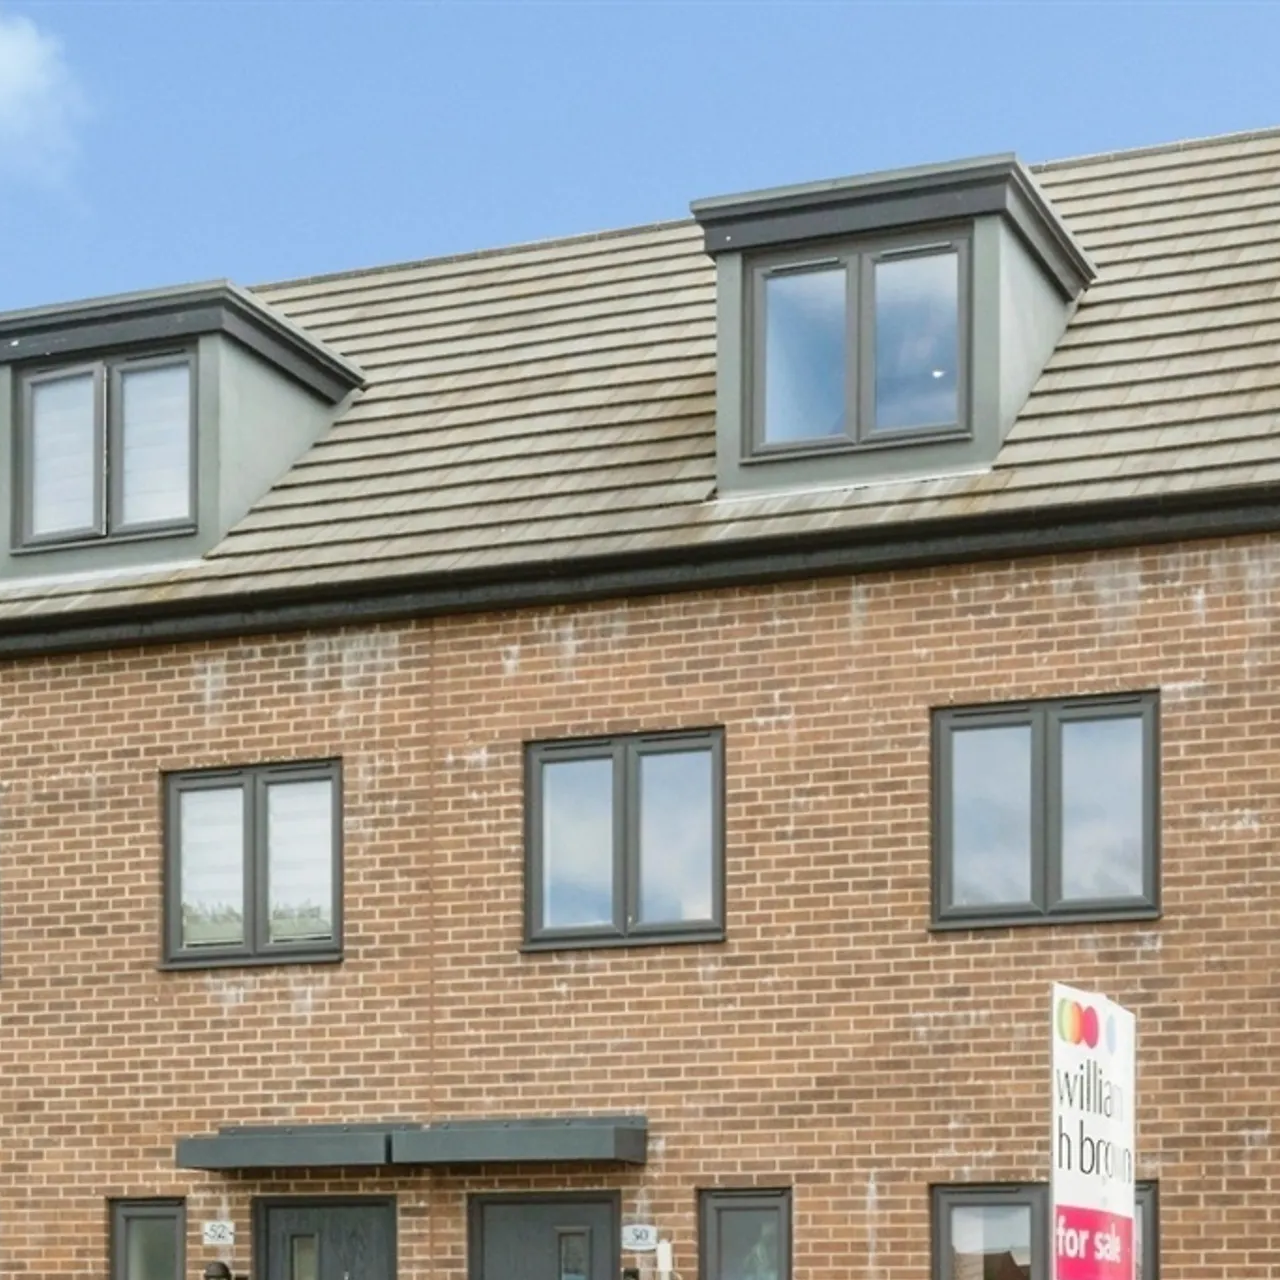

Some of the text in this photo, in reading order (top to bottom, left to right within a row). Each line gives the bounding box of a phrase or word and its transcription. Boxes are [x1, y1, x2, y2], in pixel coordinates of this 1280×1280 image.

[1058, 1114, 1132, 1184] h bron
[209, 1223, 227, 1240] 52
[631, 1227, 649, 1241] 50
[1057, 1214, 1089, 1259] for
